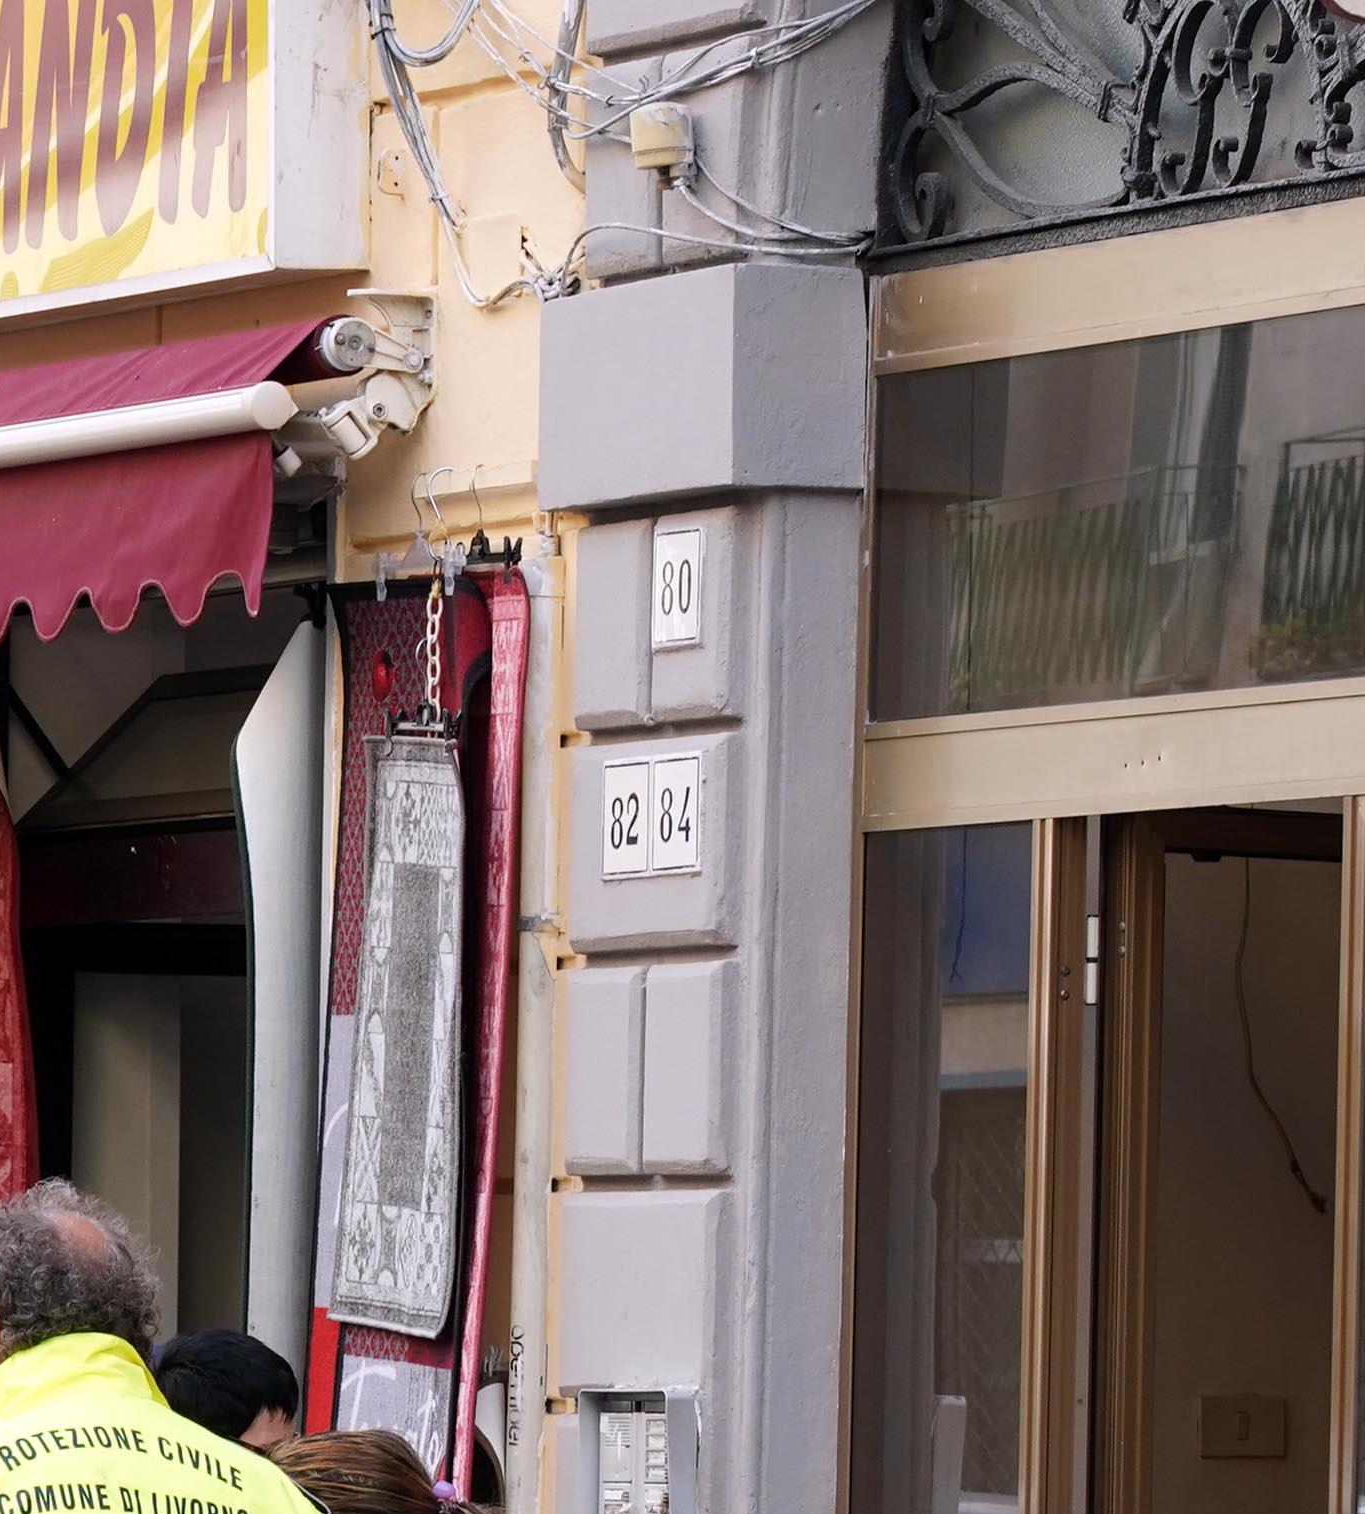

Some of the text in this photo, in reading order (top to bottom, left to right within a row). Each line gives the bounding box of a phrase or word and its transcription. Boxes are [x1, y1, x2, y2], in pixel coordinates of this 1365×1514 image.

[660, 558, 692, 616] 80
[610, 786, 692, 850] 82 84
[157, 1435, 243, 1492] CIVILE
